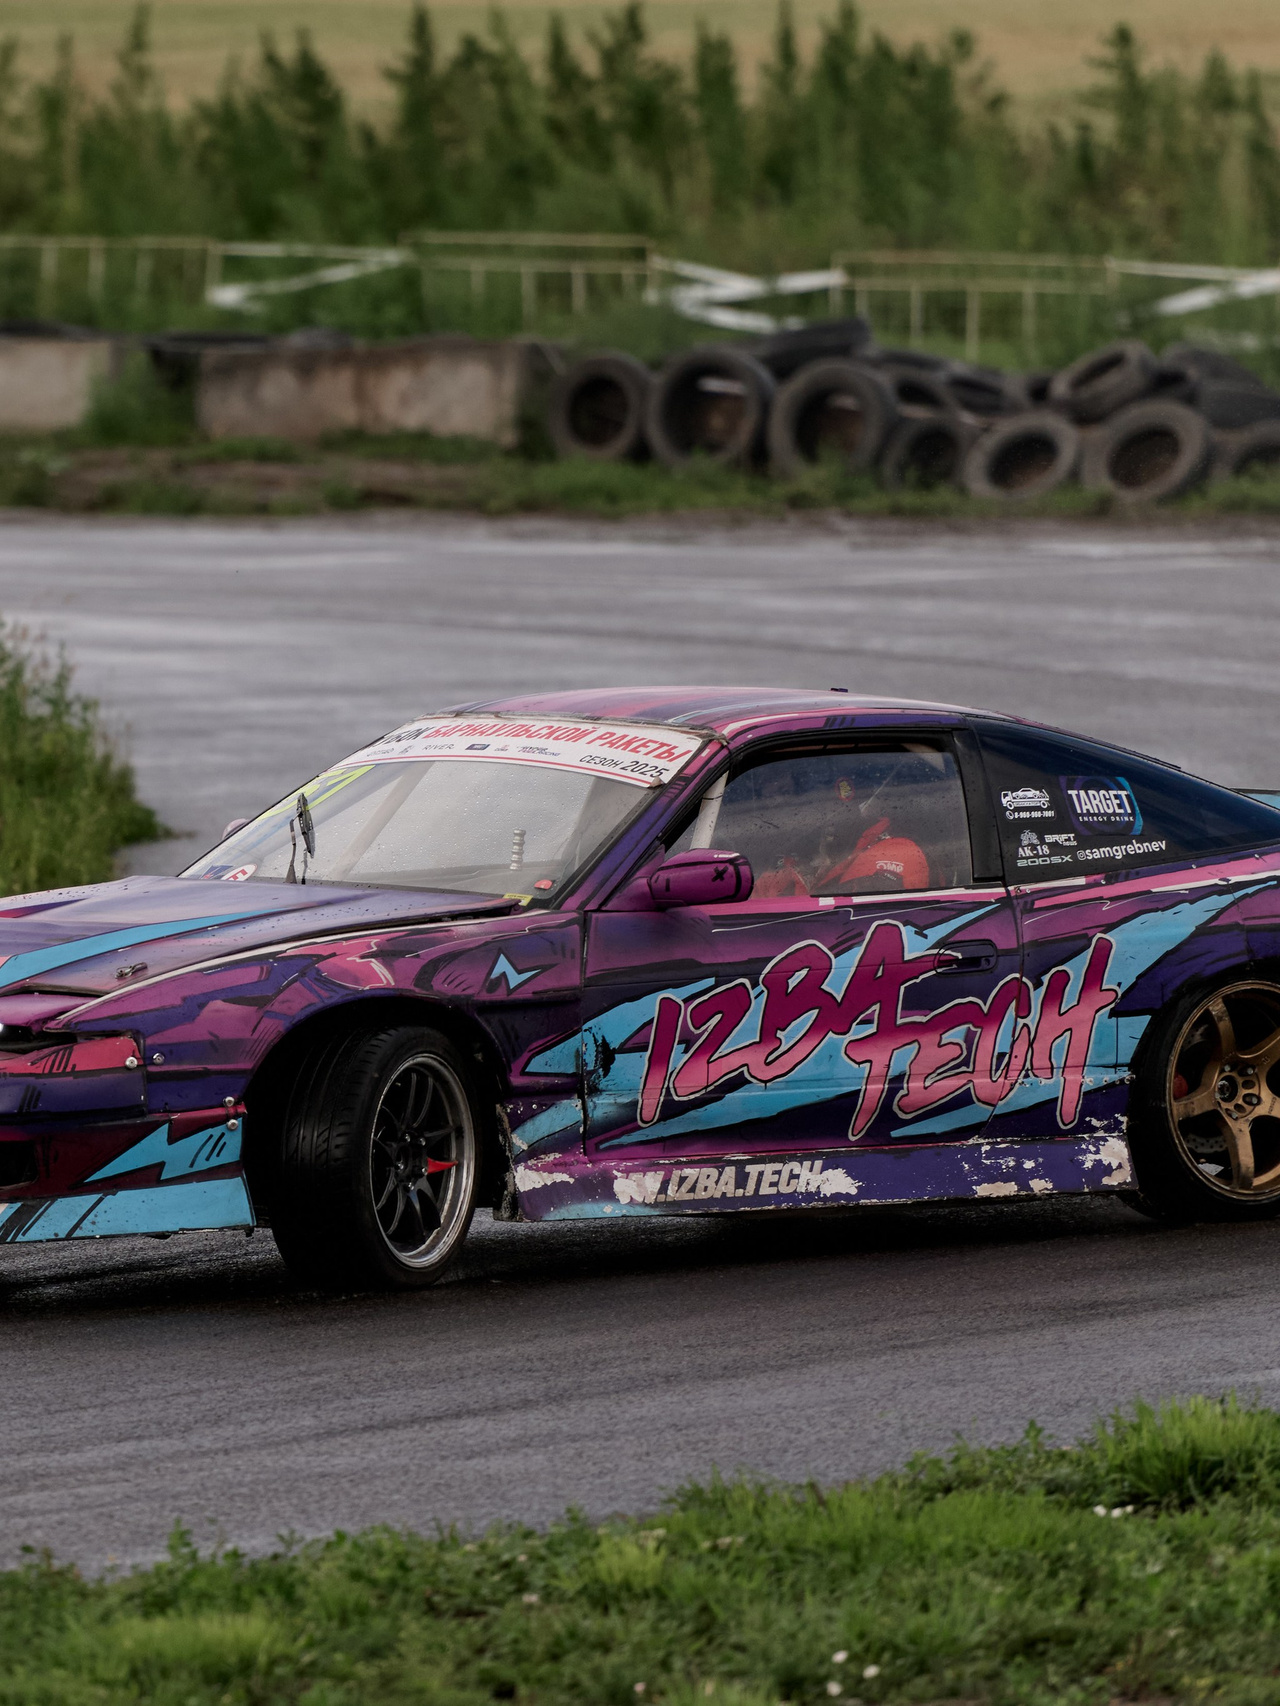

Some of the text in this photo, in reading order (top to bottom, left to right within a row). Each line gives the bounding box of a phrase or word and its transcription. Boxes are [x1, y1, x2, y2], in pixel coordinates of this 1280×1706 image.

[422, 723, 597, 743] БАРНАУЛЬСКОЙ
[587, 731, 692, 763] РАКЕТЫ
[579, 754, 670, 779] СЕЗОН 2025
[1067, 790, 1132, 814] TARGET
[1016, 855, 1073, 867] 200SX
[1018, 844, 1050, 858] AK-18
[844, 932, 1123, 1142] TECH
